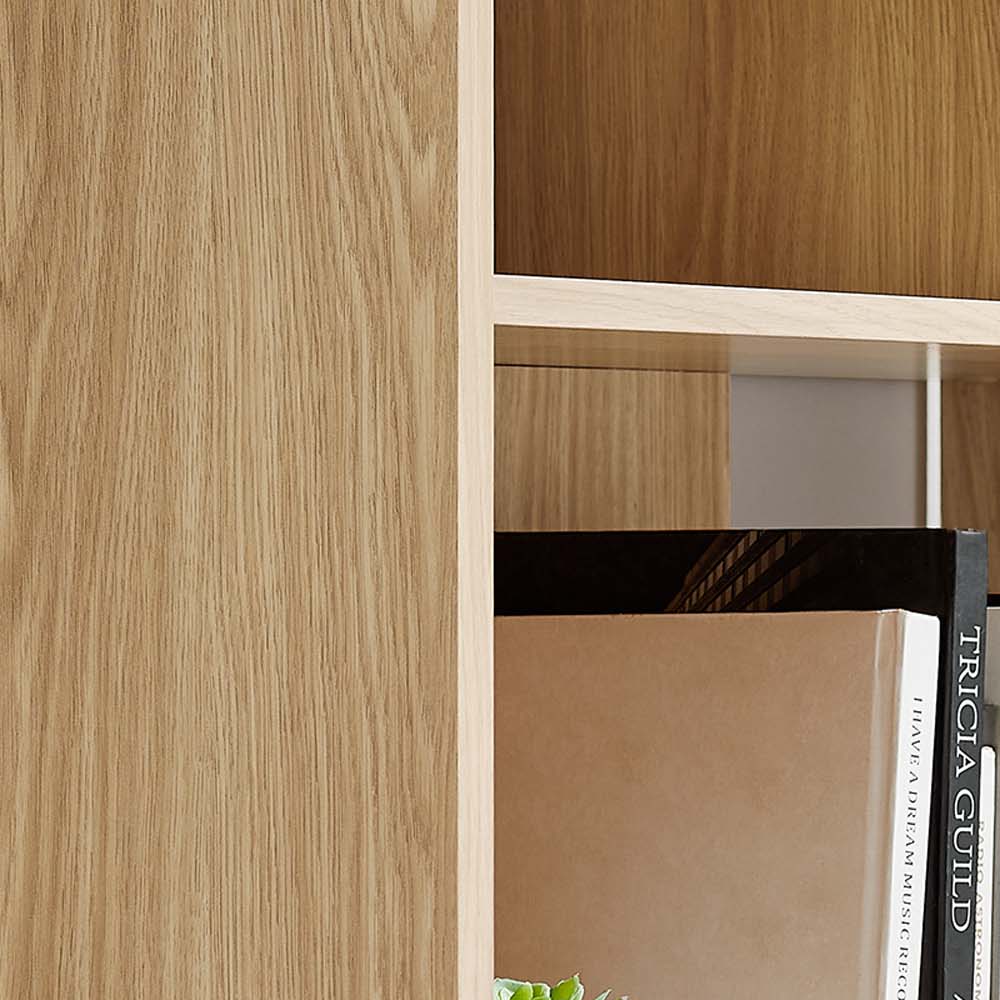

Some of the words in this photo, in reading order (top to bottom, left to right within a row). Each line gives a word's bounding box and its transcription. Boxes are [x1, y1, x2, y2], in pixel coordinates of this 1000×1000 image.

[955, 625, 982, 778] TRICIA
[909, 709, 922, 766] HAVE
[909, 770, 919, 783] A
[904, 791, 918, 866] DREAM
[951, 788, 975, 932] GUILD
[900, 873, 913, 940] MUSIC
